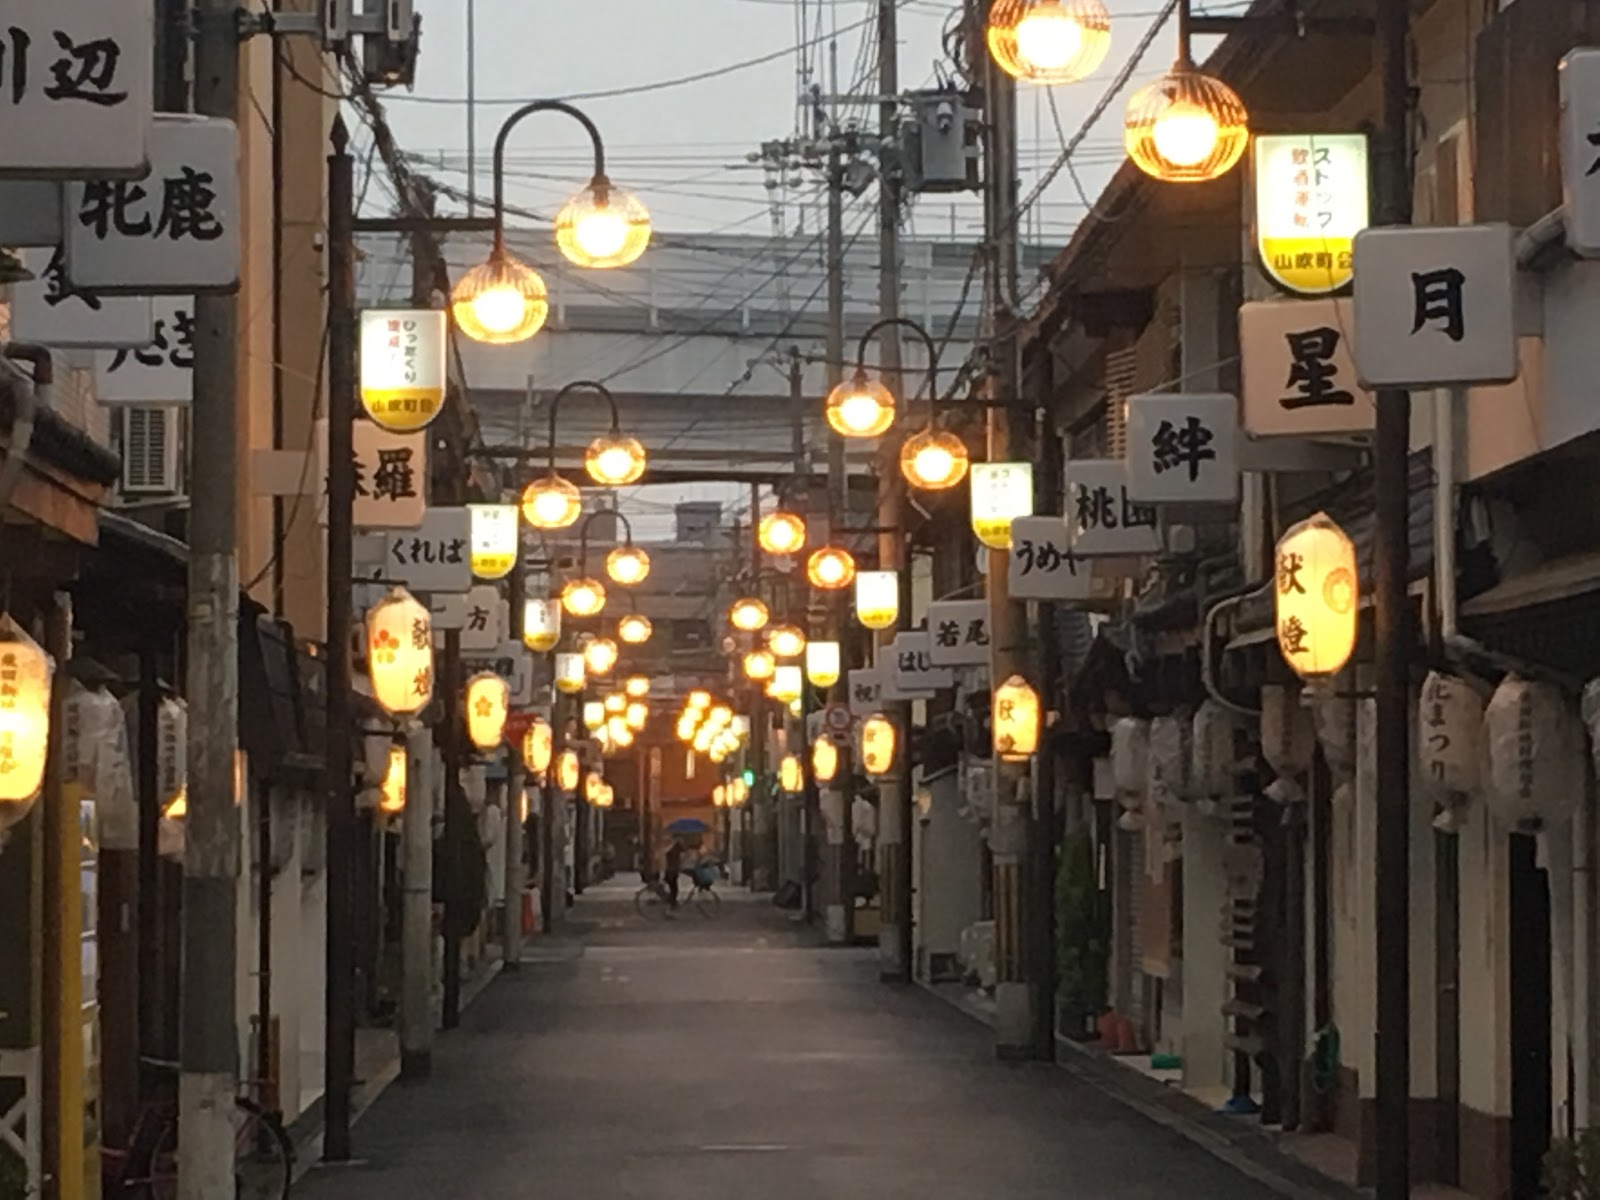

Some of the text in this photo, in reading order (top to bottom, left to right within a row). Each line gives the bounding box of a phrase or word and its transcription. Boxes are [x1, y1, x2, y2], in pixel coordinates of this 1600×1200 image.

[1410, 267, 1466, 342] 月
[1278, 326, 1355, 411] 星
[1151, 416, 1216, 483] 絆
